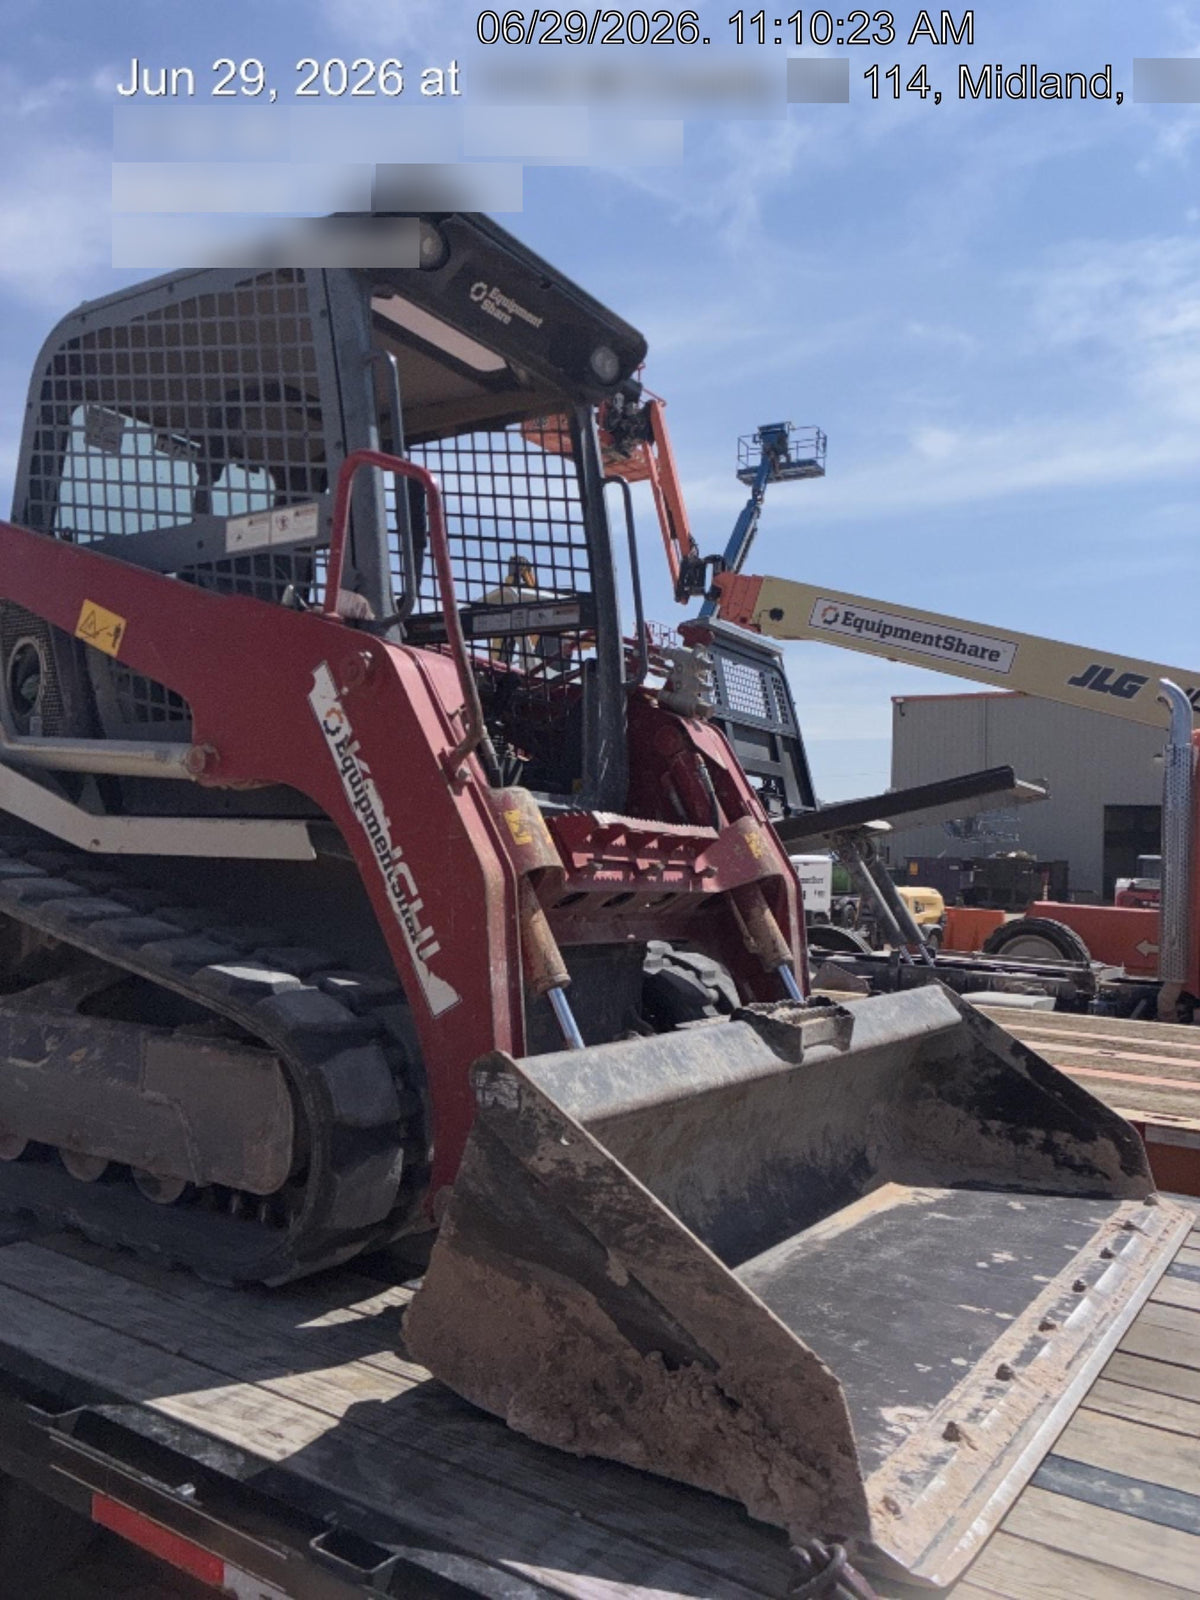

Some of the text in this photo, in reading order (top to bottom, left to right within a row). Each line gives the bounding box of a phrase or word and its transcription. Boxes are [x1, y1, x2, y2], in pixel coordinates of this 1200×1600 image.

[488, 287, 543, 328] Equipment
[841, 610, 1001, 663] EquipmentShare
[1067, 664, 1150, 699] JLG
